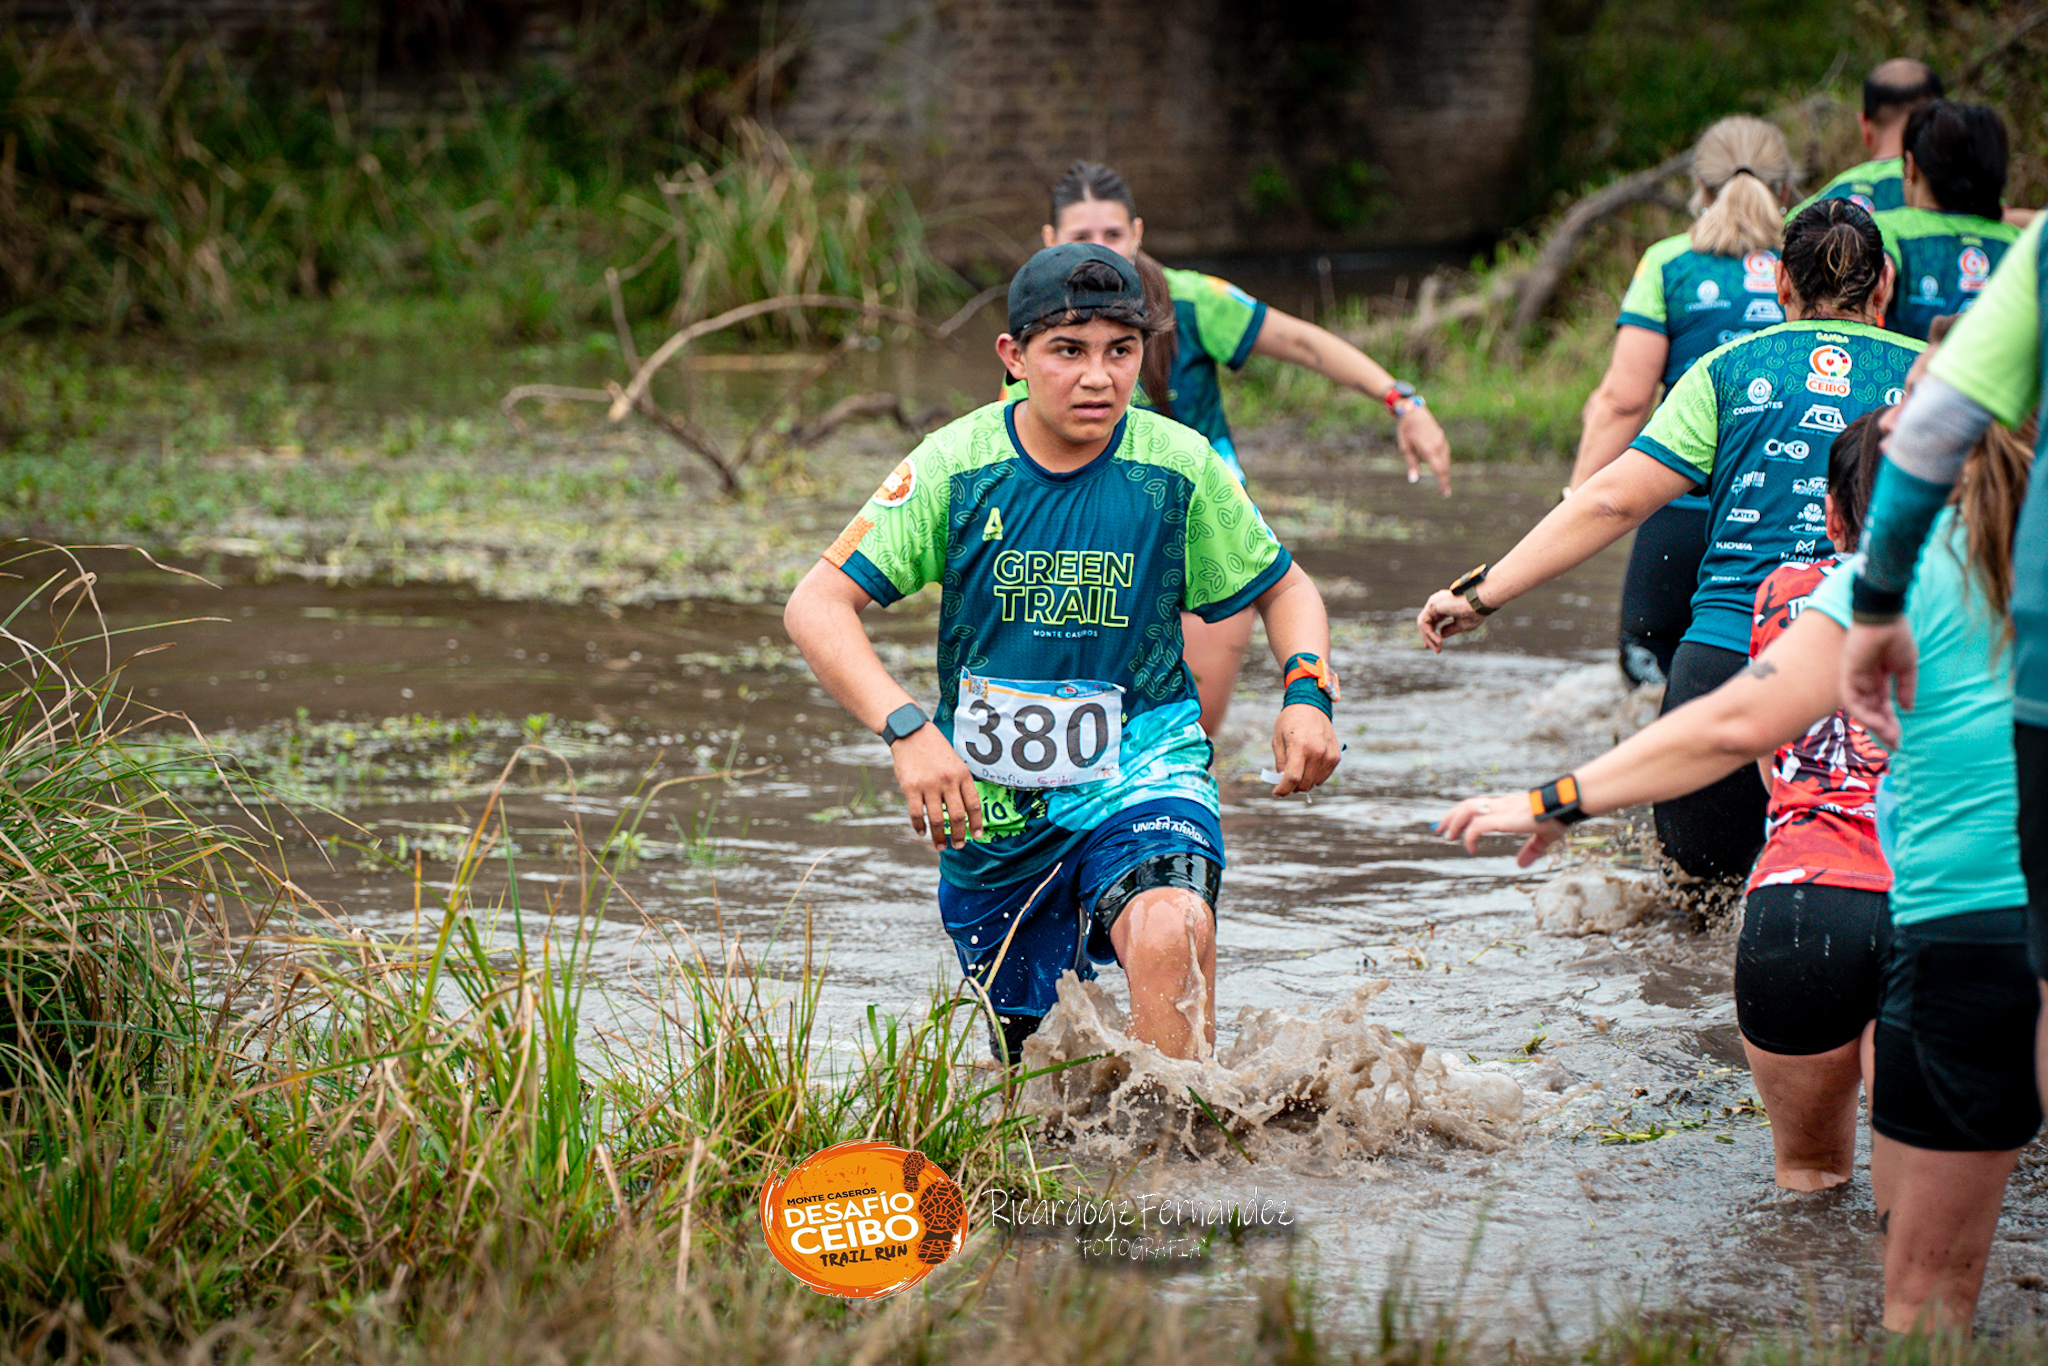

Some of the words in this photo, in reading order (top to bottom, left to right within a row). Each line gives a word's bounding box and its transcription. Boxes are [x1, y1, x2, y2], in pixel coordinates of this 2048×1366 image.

[1808, 380, 1847, 394] CEIBO
[1715, 542, 1753, 551] KIOWA
[993, 550, 1134, 587] GREEN
[993, 585, 1129, 627] TRAIL
[1033, 630, 1063, 638] MONTE
[965, 699, 1109, 772] 380
[1132, 820, 1170, 833] UNDER
